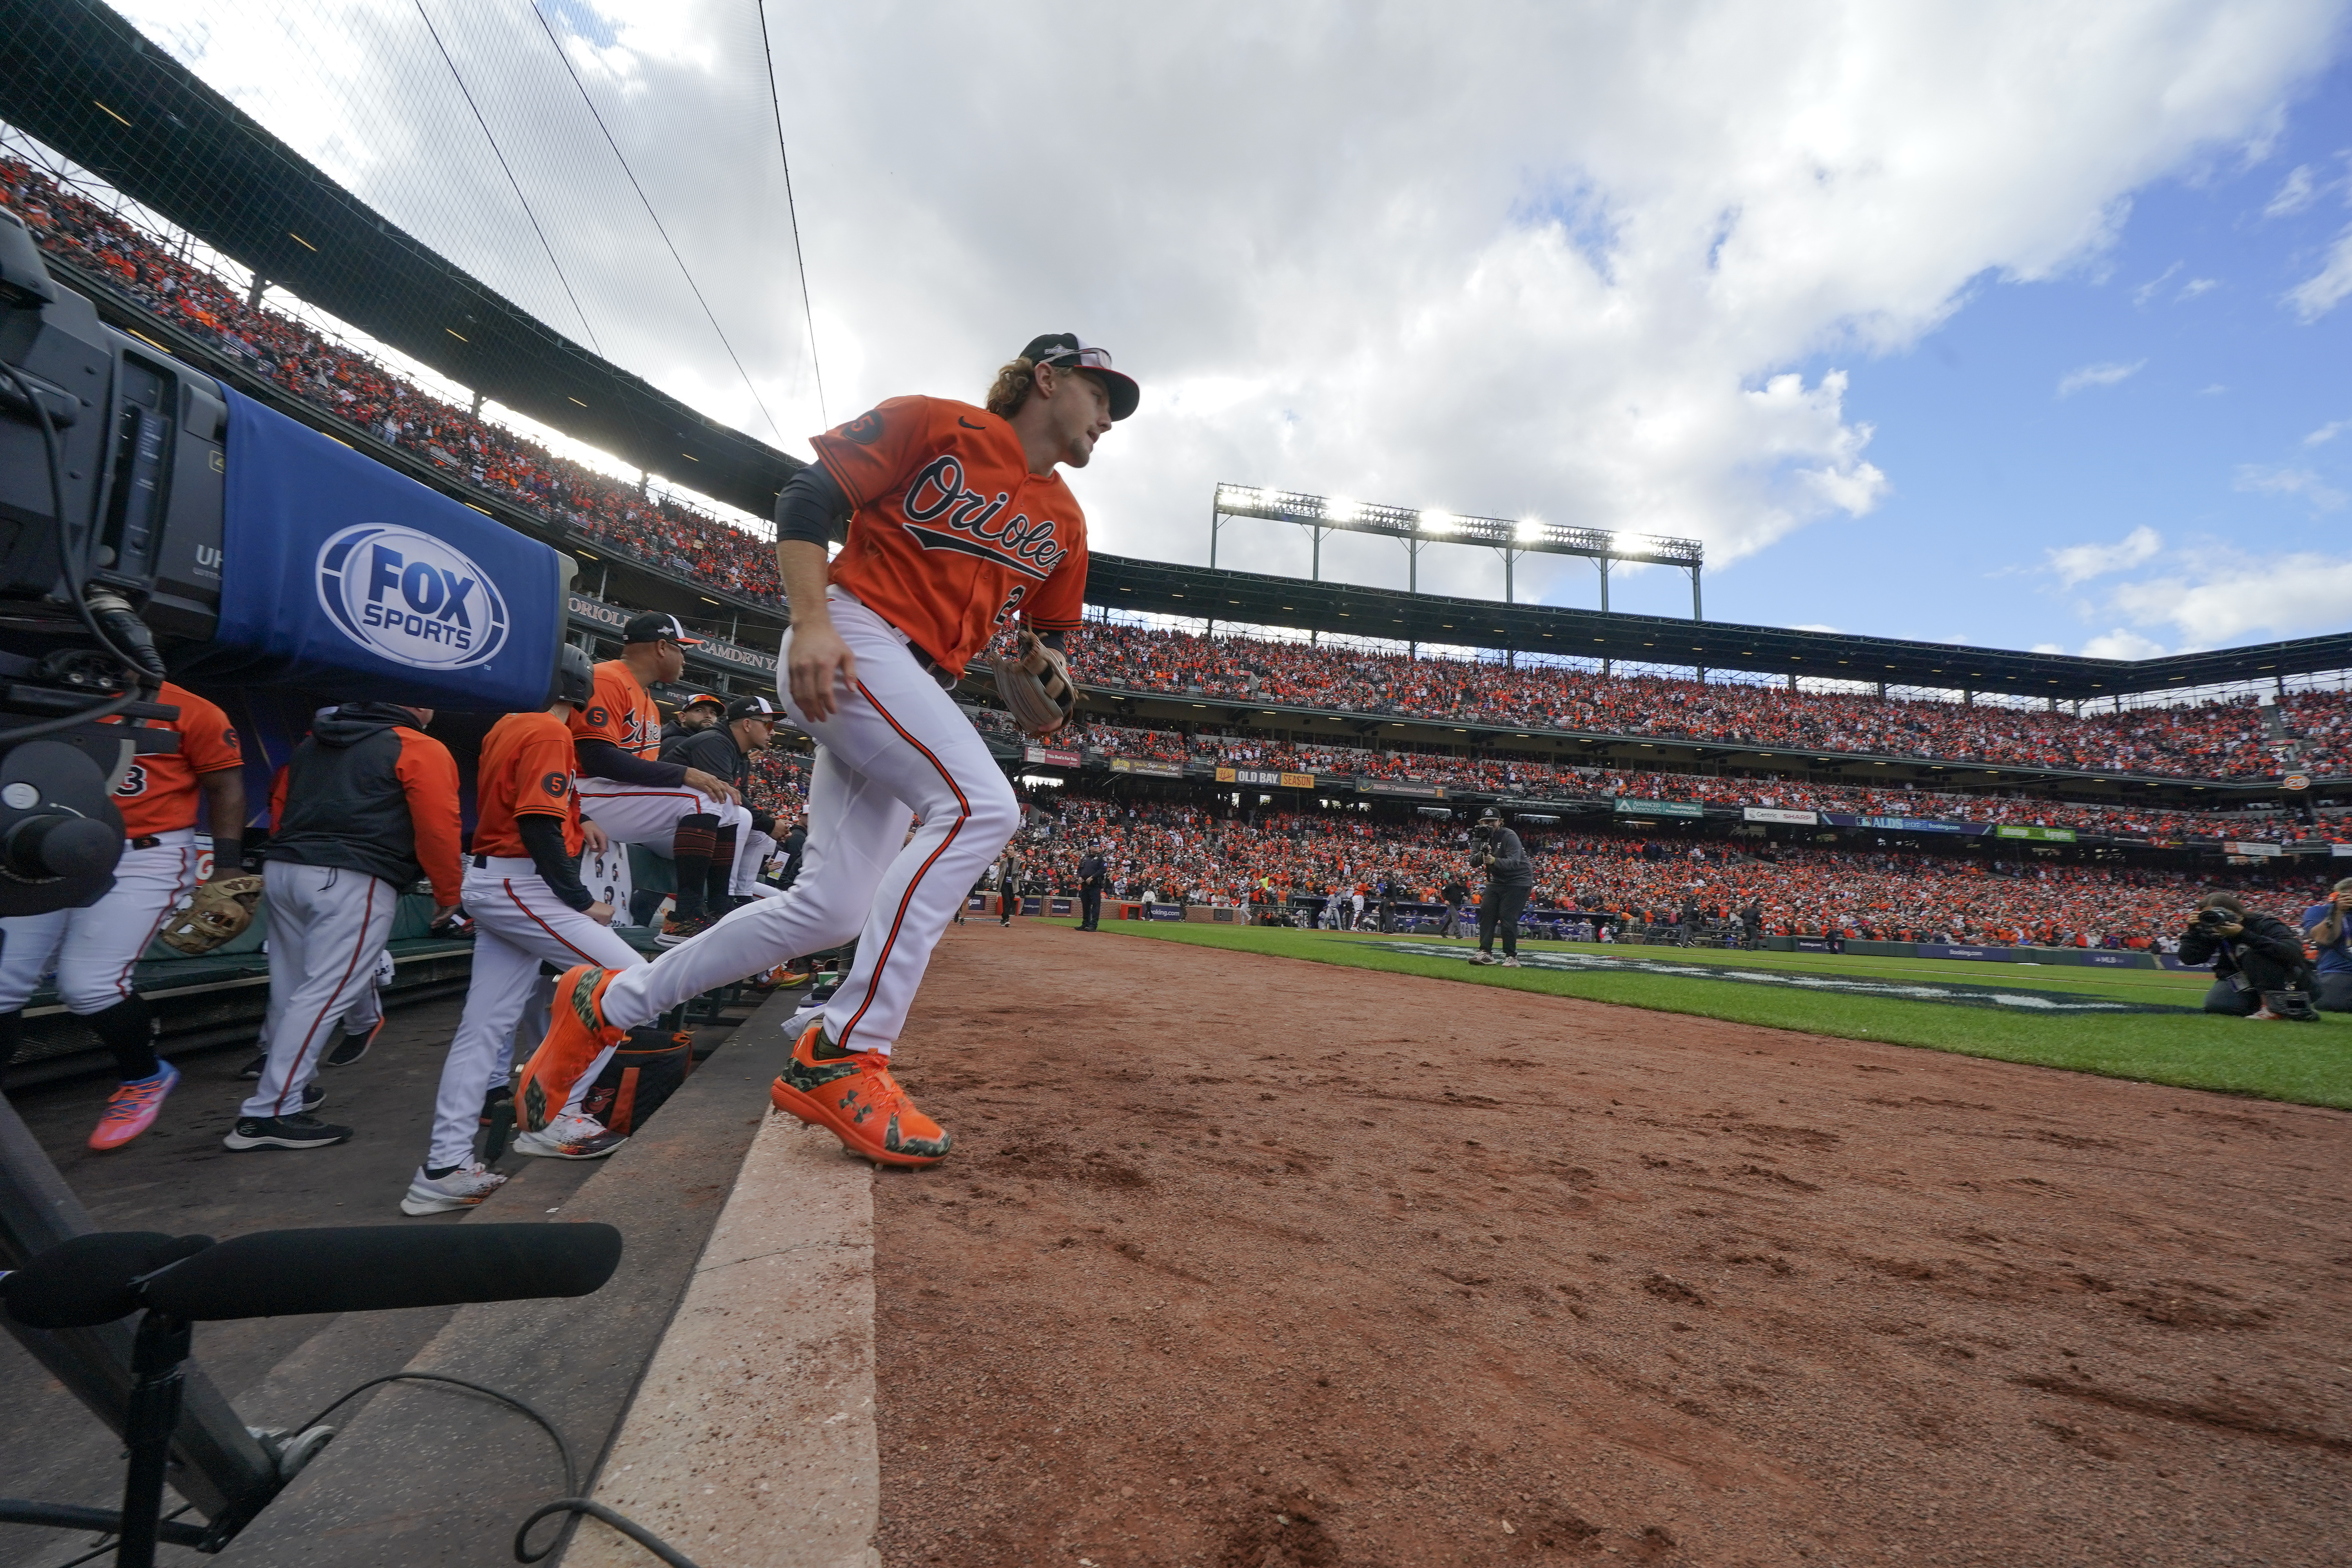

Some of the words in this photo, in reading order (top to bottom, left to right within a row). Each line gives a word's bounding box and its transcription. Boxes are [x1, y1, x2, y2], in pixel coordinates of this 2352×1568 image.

[850, 415, 875, 432] 5
[903, 454, 1068, 573] Orioles
[368, 543, 475, 630] FOX
[993, 584, 1026, 625] 2
[363, 603, 471, 650] SPORTS
[697, 639, 764, 668] CAMDEN
[667, 691, 688, 701] mas
[593, 711, 604, 722] 5
[551, 777, 563, 792] 5
[1238, 771, 1257, 782] OLD
[1284, 775, 1311, 786] SEASON
[1872, 817, 1903, 829] ALDS
